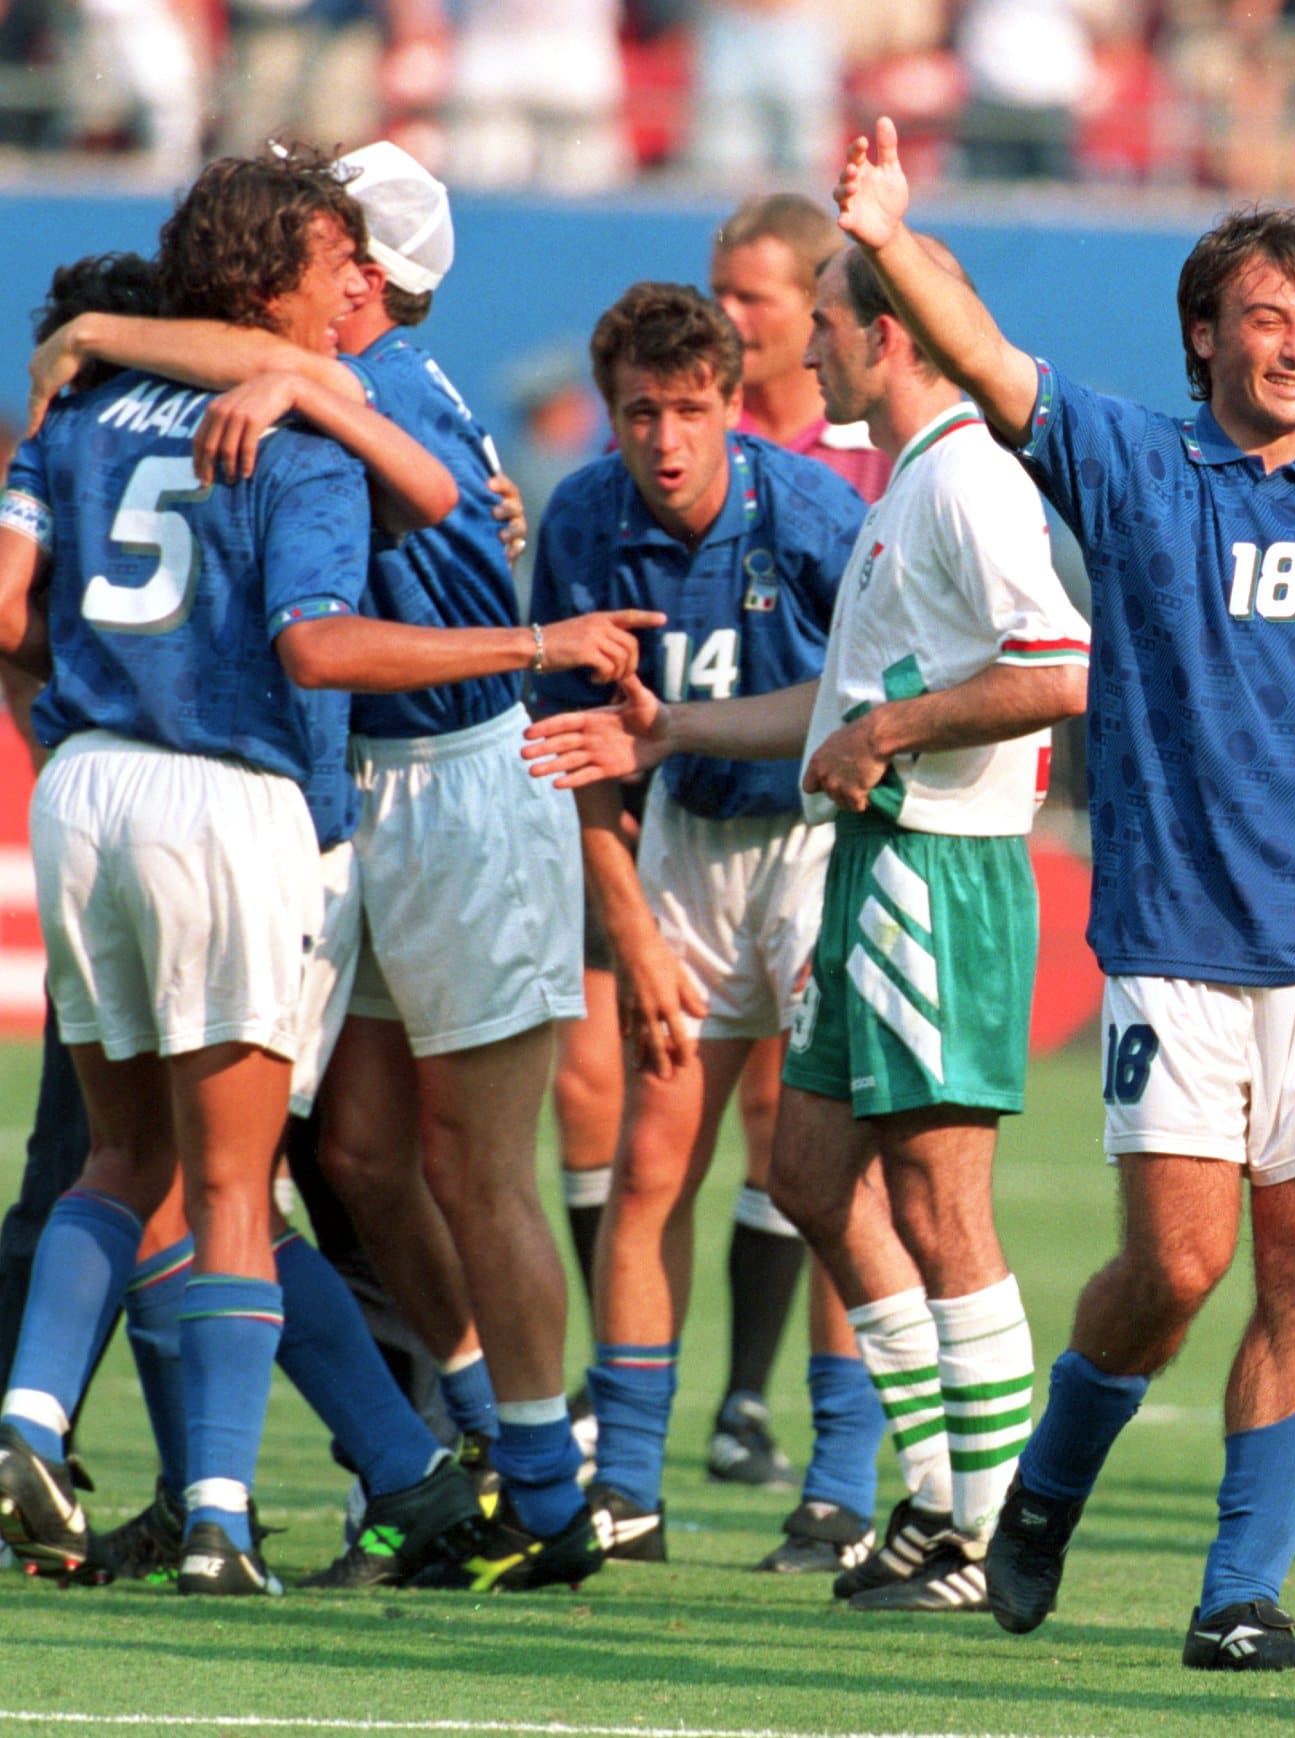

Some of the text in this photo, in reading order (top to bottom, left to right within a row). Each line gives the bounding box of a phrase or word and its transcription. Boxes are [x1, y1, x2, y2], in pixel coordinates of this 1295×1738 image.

[81, 456, 202, 635] 5
[662, 628, 741, 703] 14
[1103, 1023, 1160, 1106] 18
